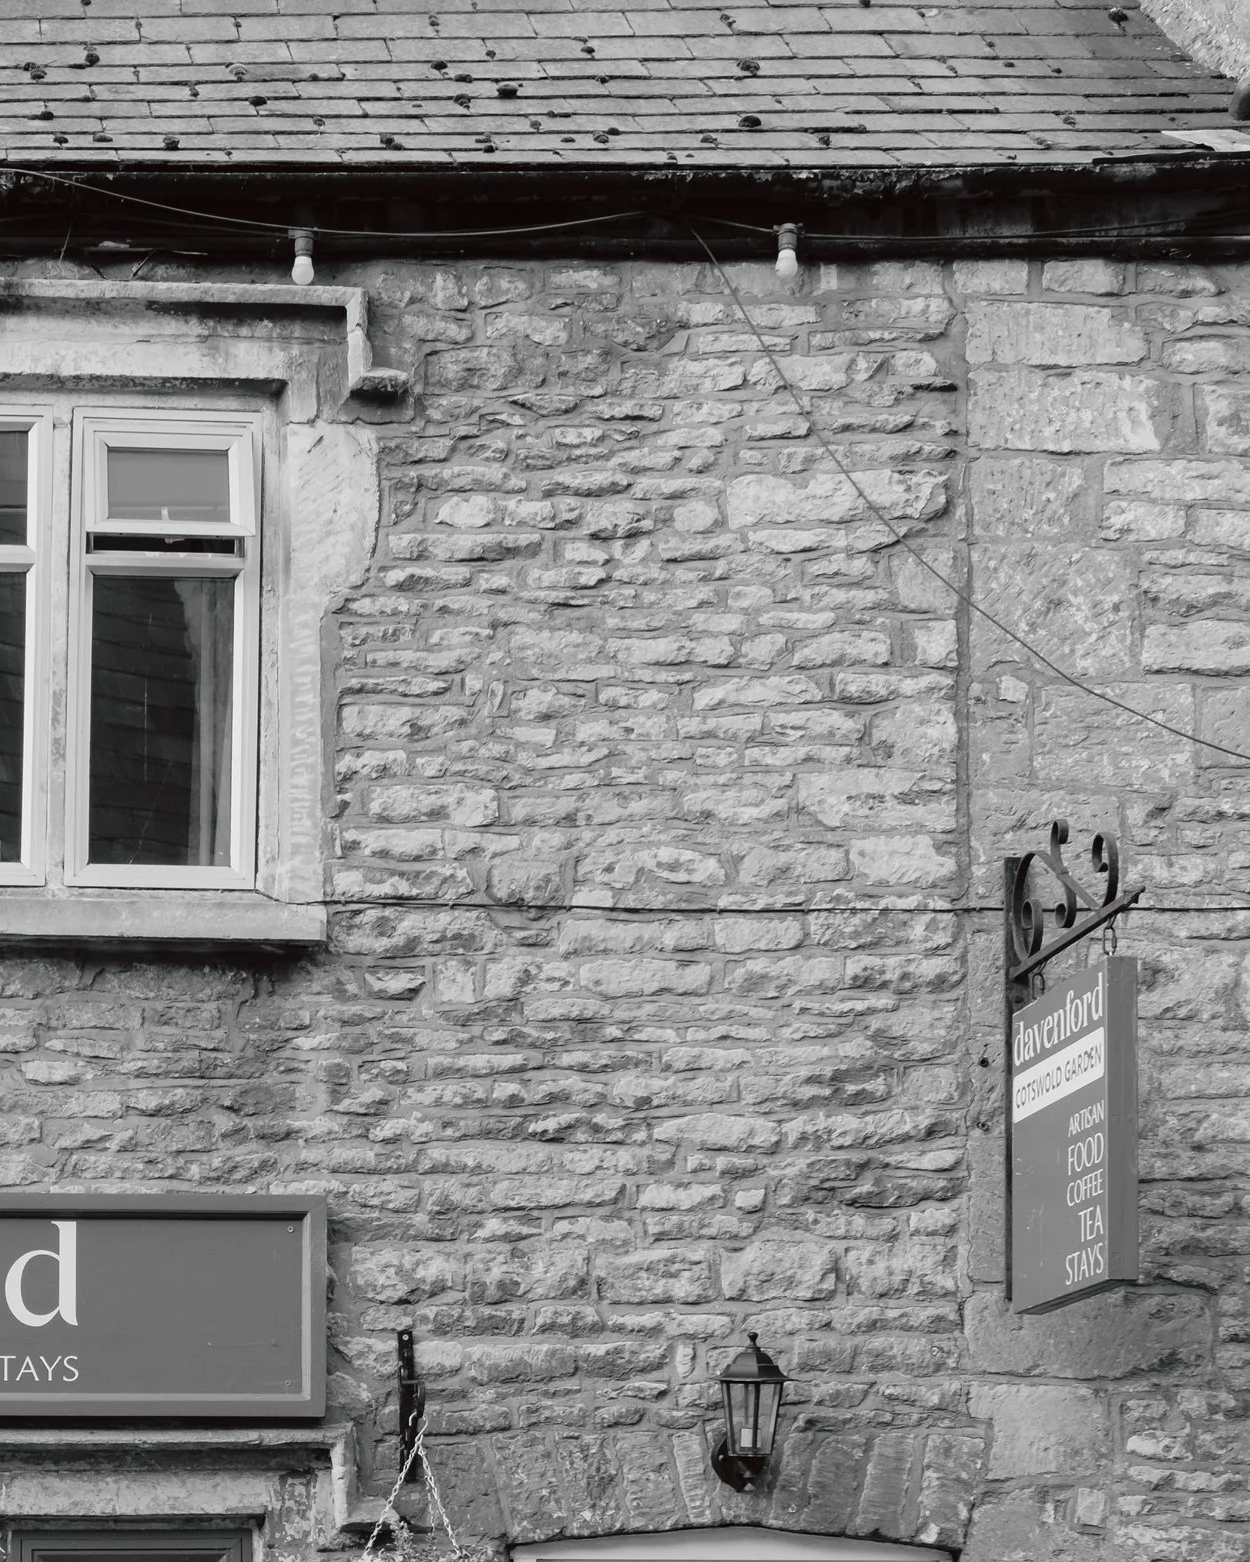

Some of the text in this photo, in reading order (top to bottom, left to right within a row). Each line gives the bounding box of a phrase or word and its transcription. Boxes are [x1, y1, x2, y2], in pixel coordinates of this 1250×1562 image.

[1013, 972, 1104, 1067] davenford
[1015, 1043, 1102, 1109] COTSWOLD GARDEN
[1067, 1099, 1105, 1138] ARTISAN
[1067, 1132, 1104, 1176] FOOD
[1066, 1169, 1104, 1207] COFFEE
[1078, 1204, 1104, 1243] TEA
[1065, 1242, 1104, 1286] STAYS
